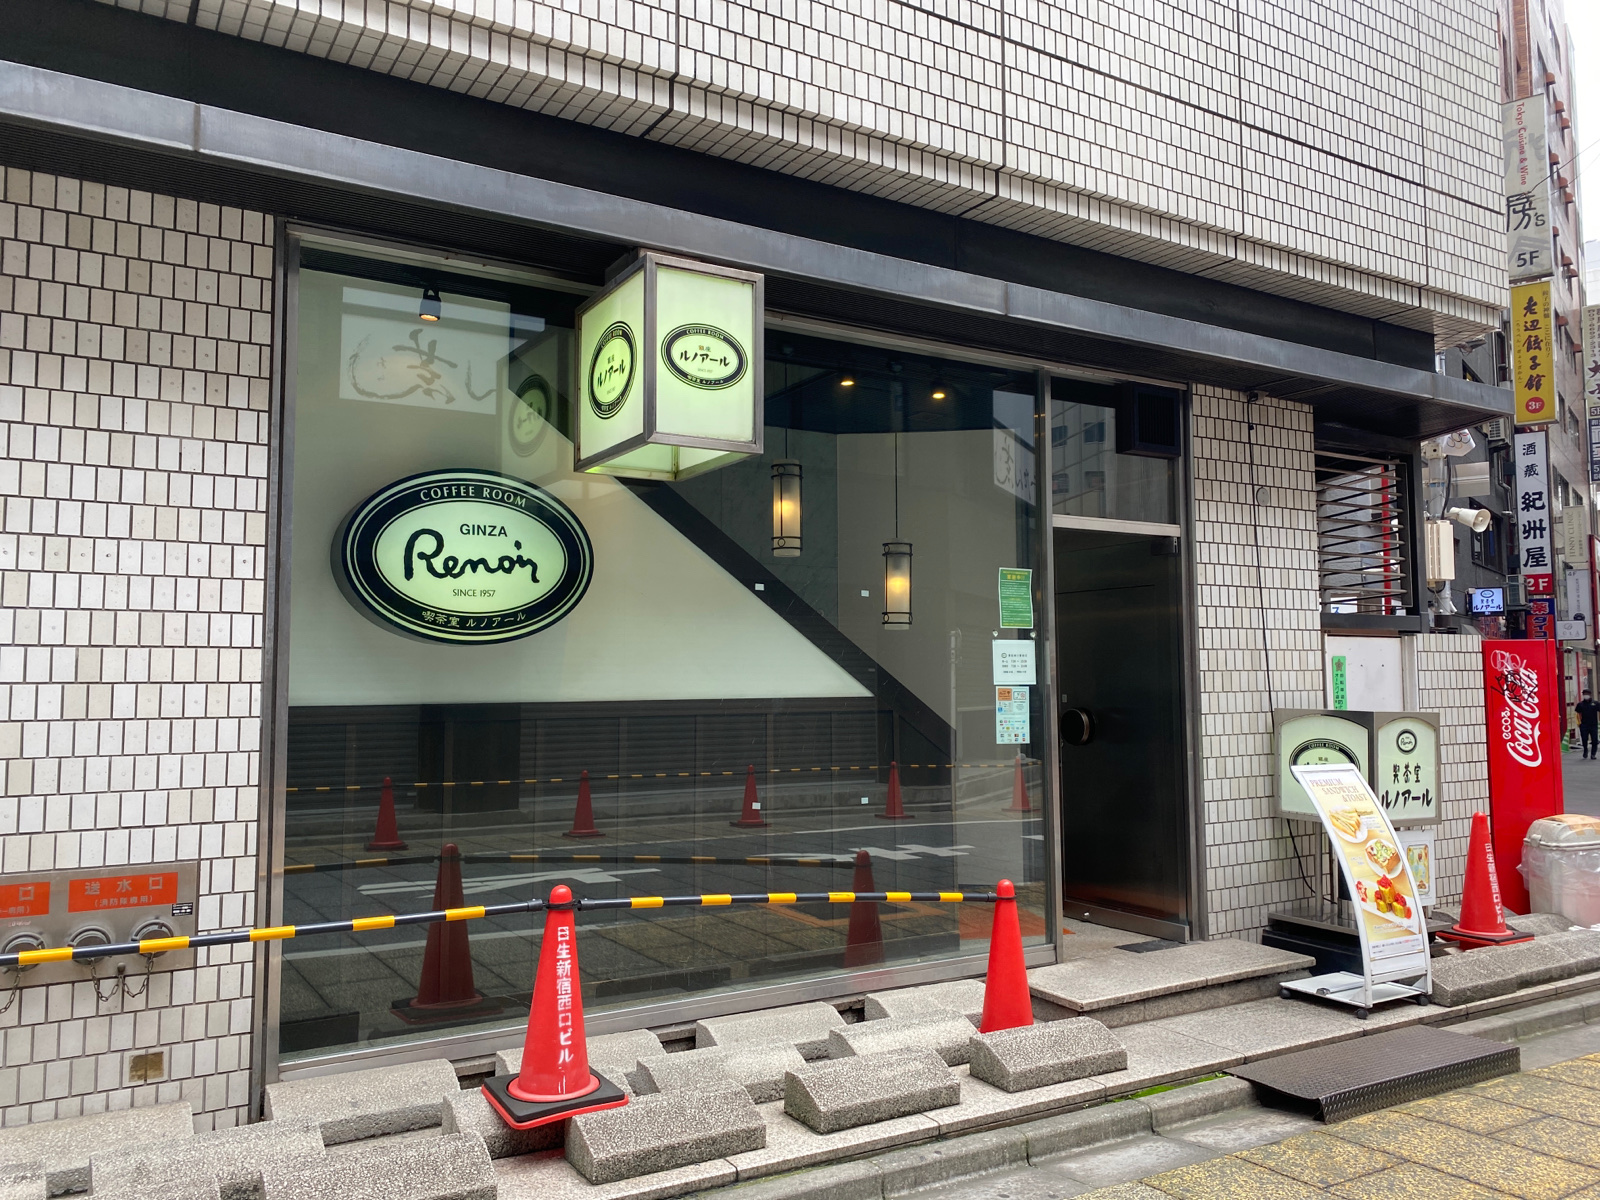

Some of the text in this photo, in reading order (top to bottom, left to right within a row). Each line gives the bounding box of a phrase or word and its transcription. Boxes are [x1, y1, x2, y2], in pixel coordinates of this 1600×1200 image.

[1516, 102, 1526, 126] Tokyo
[1518, 127, 1527, 155] Cuisine
[1520, 165, 1529, 186] Wine
[1516, 250, 1540, 268] 5F
[679, 350, 731, 368] ルノアール
[597, 359, 626, 388] ルノアール
[1528, 400, 1542, 410] 3F
[420, 485, 527, 508] COFFEE ROOM
[459, 523, 508, 538] GINZA
[1520, 490, 1548, 568] 紀州屋
[404, 528, 540, 583] Renoir
[452, 588, 496, 598] SINCE 1957
[1527, 577, 1549, 591] 2F
[421, 610, 527, 628] 喫茶室 ルノアール
[1309, 778, 1344, 787] PREMIUM
[1321, 785, 1359, 795] SANDWICH
[1381, 788, 1433, 810] ルノアール
[84, 876, 163, 896] 送水口
[556, 926, 574, 1064] 日生新宿西口ビル
